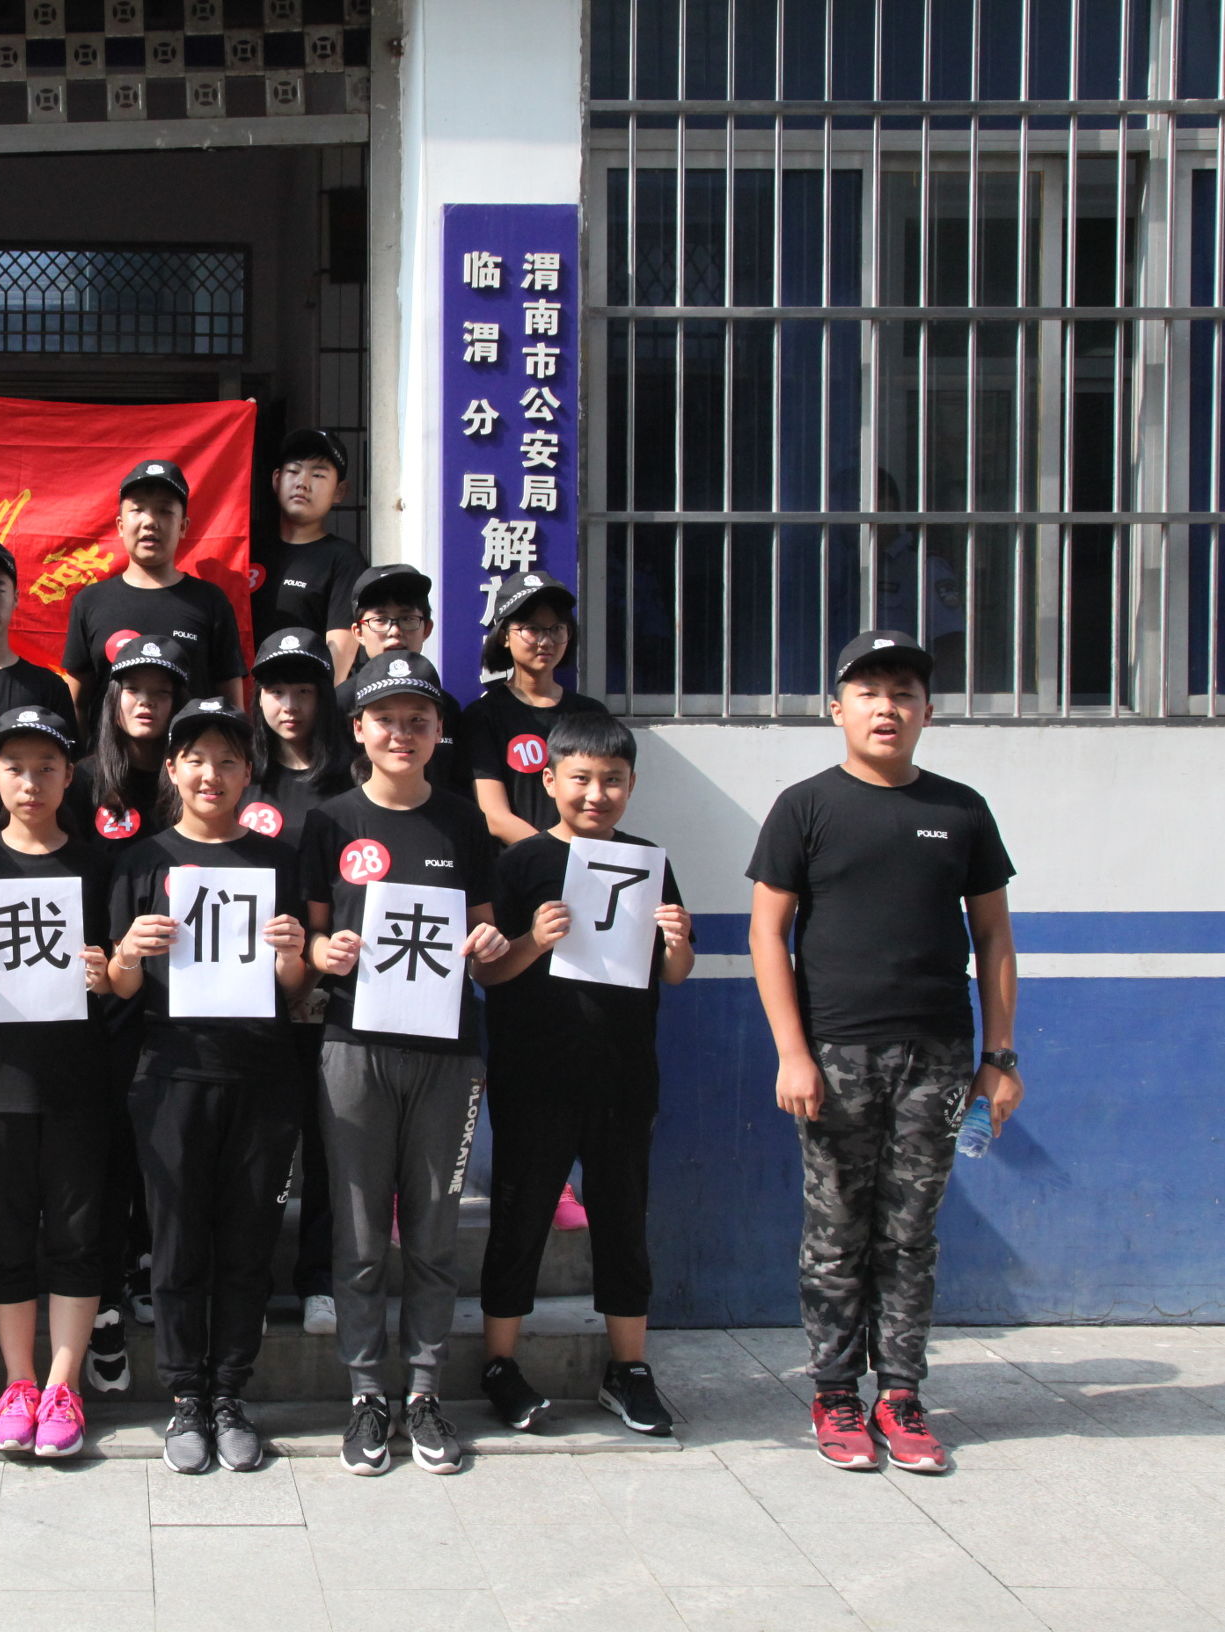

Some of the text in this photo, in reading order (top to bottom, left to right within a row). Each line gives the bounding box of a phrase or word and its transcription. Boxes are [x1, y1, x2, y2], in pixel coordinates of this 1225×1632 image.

[459, 250, 503, 511] 临渭分局
[519, 251, 560, 512] 渭南市公安局
[283, 579, 308, 589] POLICE
[172, 630, 198, 641] POLICE
[513, 740, 544, 767] 10
[916, 829, 949, 840] POLICE
[346, 845, 383, 880] 28
[424, 859, 454, 868] POLICE
[586, 861, 651, 932] 了
[184, 885, 258, 965] 们
[374, 903, 453, 982] 来
